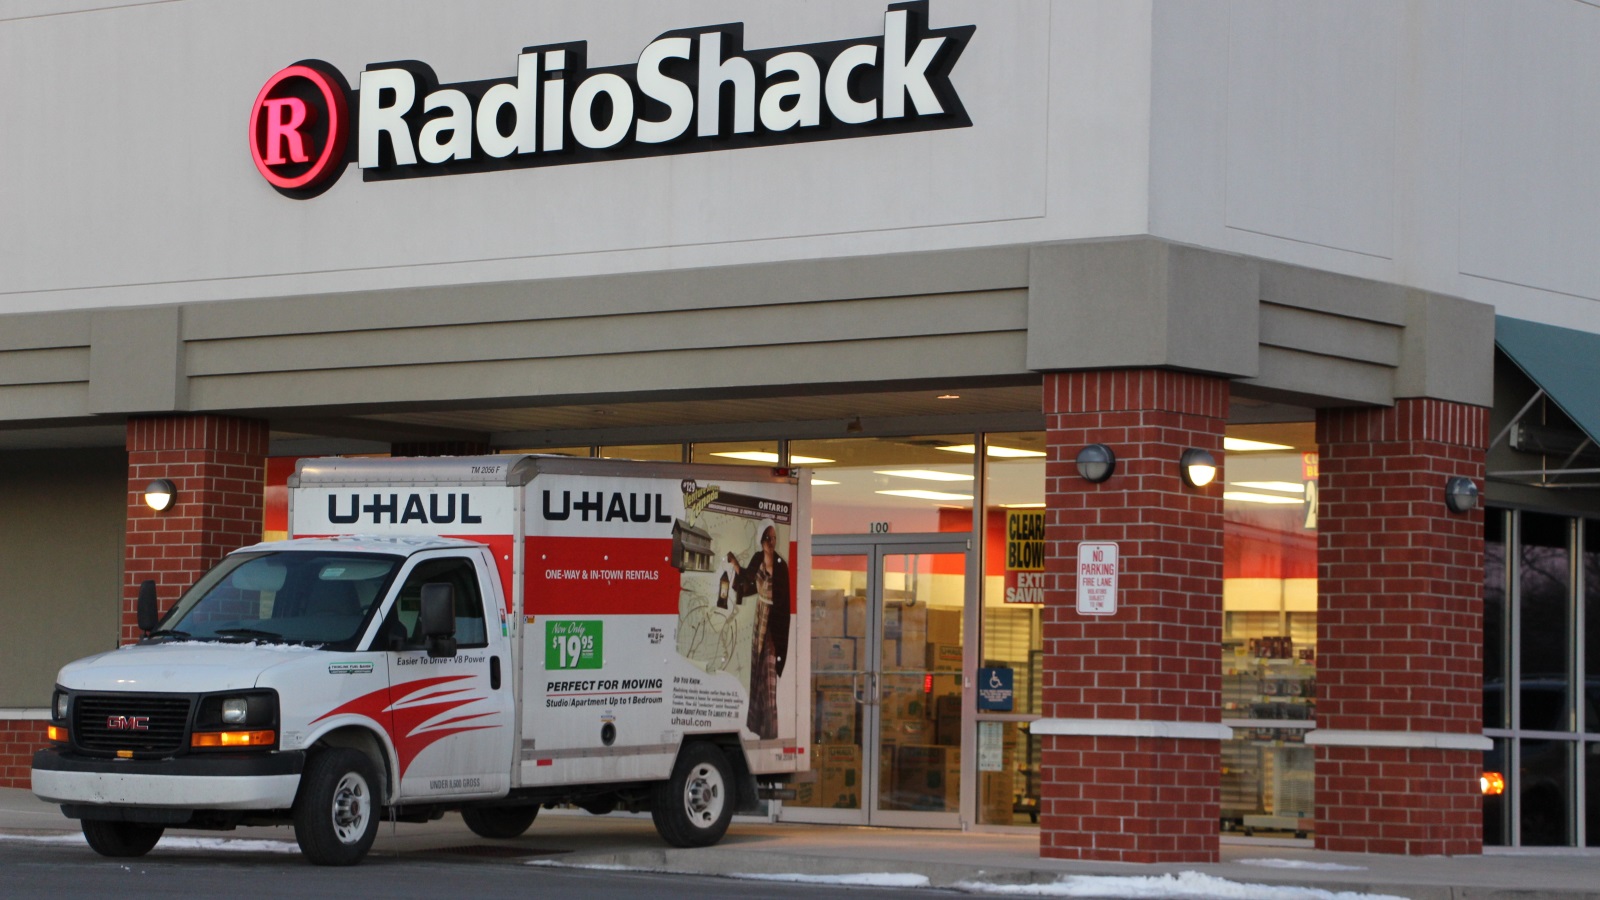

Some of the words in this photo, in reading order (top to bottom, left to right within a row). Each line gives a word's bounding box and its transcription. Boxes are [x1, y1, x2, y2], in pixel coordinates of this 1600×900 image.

[358, 9, 949, 170] RadioShack
[471, 466, 480, 474] TM
[481, 466, 495, 474] 2056
[496, 465, 500, 474] F
[328, 493, 482, 524] U-HAUL
[542, 490, 672, 523] U-HAUL
[758, 500, 788, 514] ONTARIO
[870, 522, 888, 533] 100
[1008, 542, 1045, 568] BLOW
[1092, 550, 1104, 562] NO
[545, 569, 580, 580] ONE-WAY
[582, 570, 588, 580] &
[590, 570, 624, 580] IN-TOWN
[626, 570, 659, 580] RENTALS
[1081, 563, 1114, 576] PARKING
[1082, 578, 1094, 587] FIRE
[1096, 578, 1112, 587] LANE
[552, 622, 566, 634] Now
[568, 622, 586, 638] Only
[396, 656, 418, 666] Easier
[420, 656, 428, 664] To
[430, 656, 448, 664] Drive
[454, 656, 462, 664] V8
[464, 654, 486, 664] Power
[546, 680, 596, 692] PERFECT
[597, 680, 619, 690] FOR
[622, 679, 663, 690] MOVING
[546, 697, 607, 708] Studio/Apartment
[610, 697, 618, 707] Up
[632, 696, 663, 704] Bedroom
[106, 716, 150, 730] GMC
[671, 717, 712, 727] uhaul.com
[430, 780, 448, 790] UNDER
[463, 778, 480, 788] GROSS
